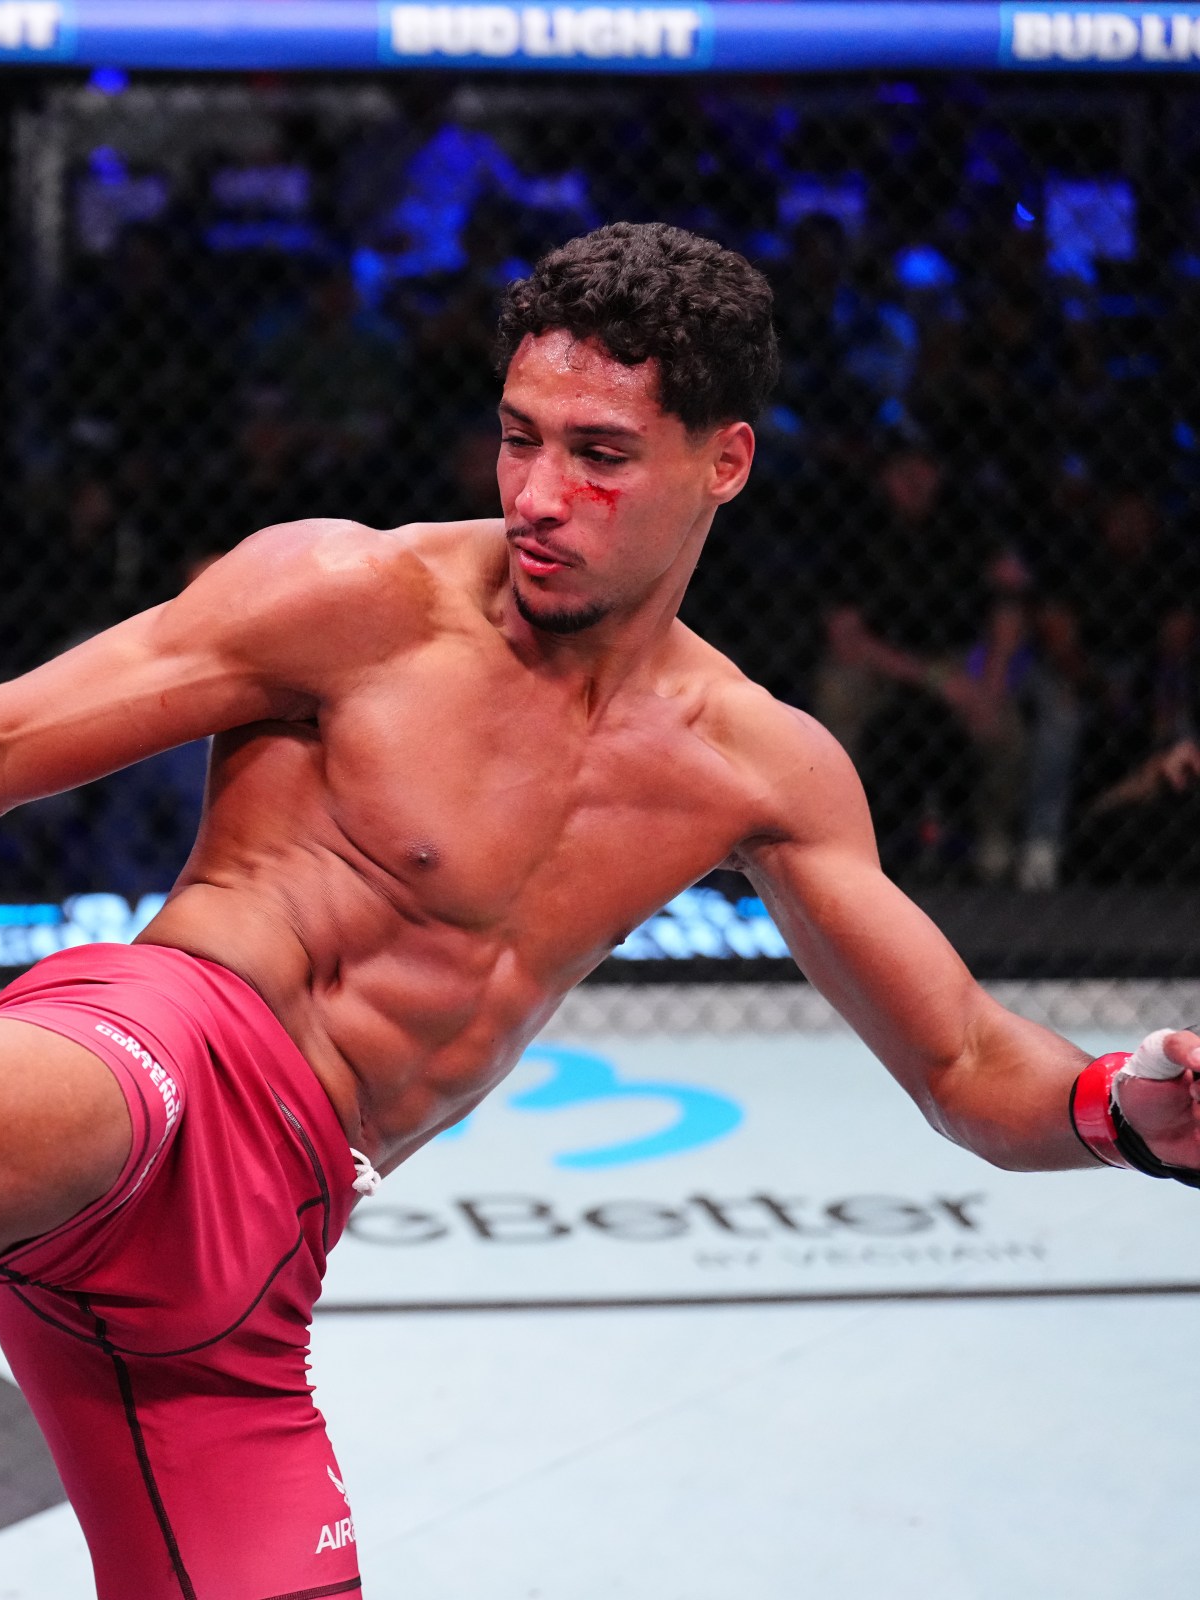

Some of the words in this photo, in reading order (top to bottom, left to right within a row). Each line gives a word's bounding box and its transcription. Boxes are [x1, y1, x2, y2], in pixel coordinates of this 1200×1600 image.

[391, 6, 519, 57] BUD
[519, 8, 698, 60] LIGHT
[1012, 11, 1139, 62] BUD
[1141, 12, 1200, 63] LI
[95, 1024, 179, 1130] CONTEND
